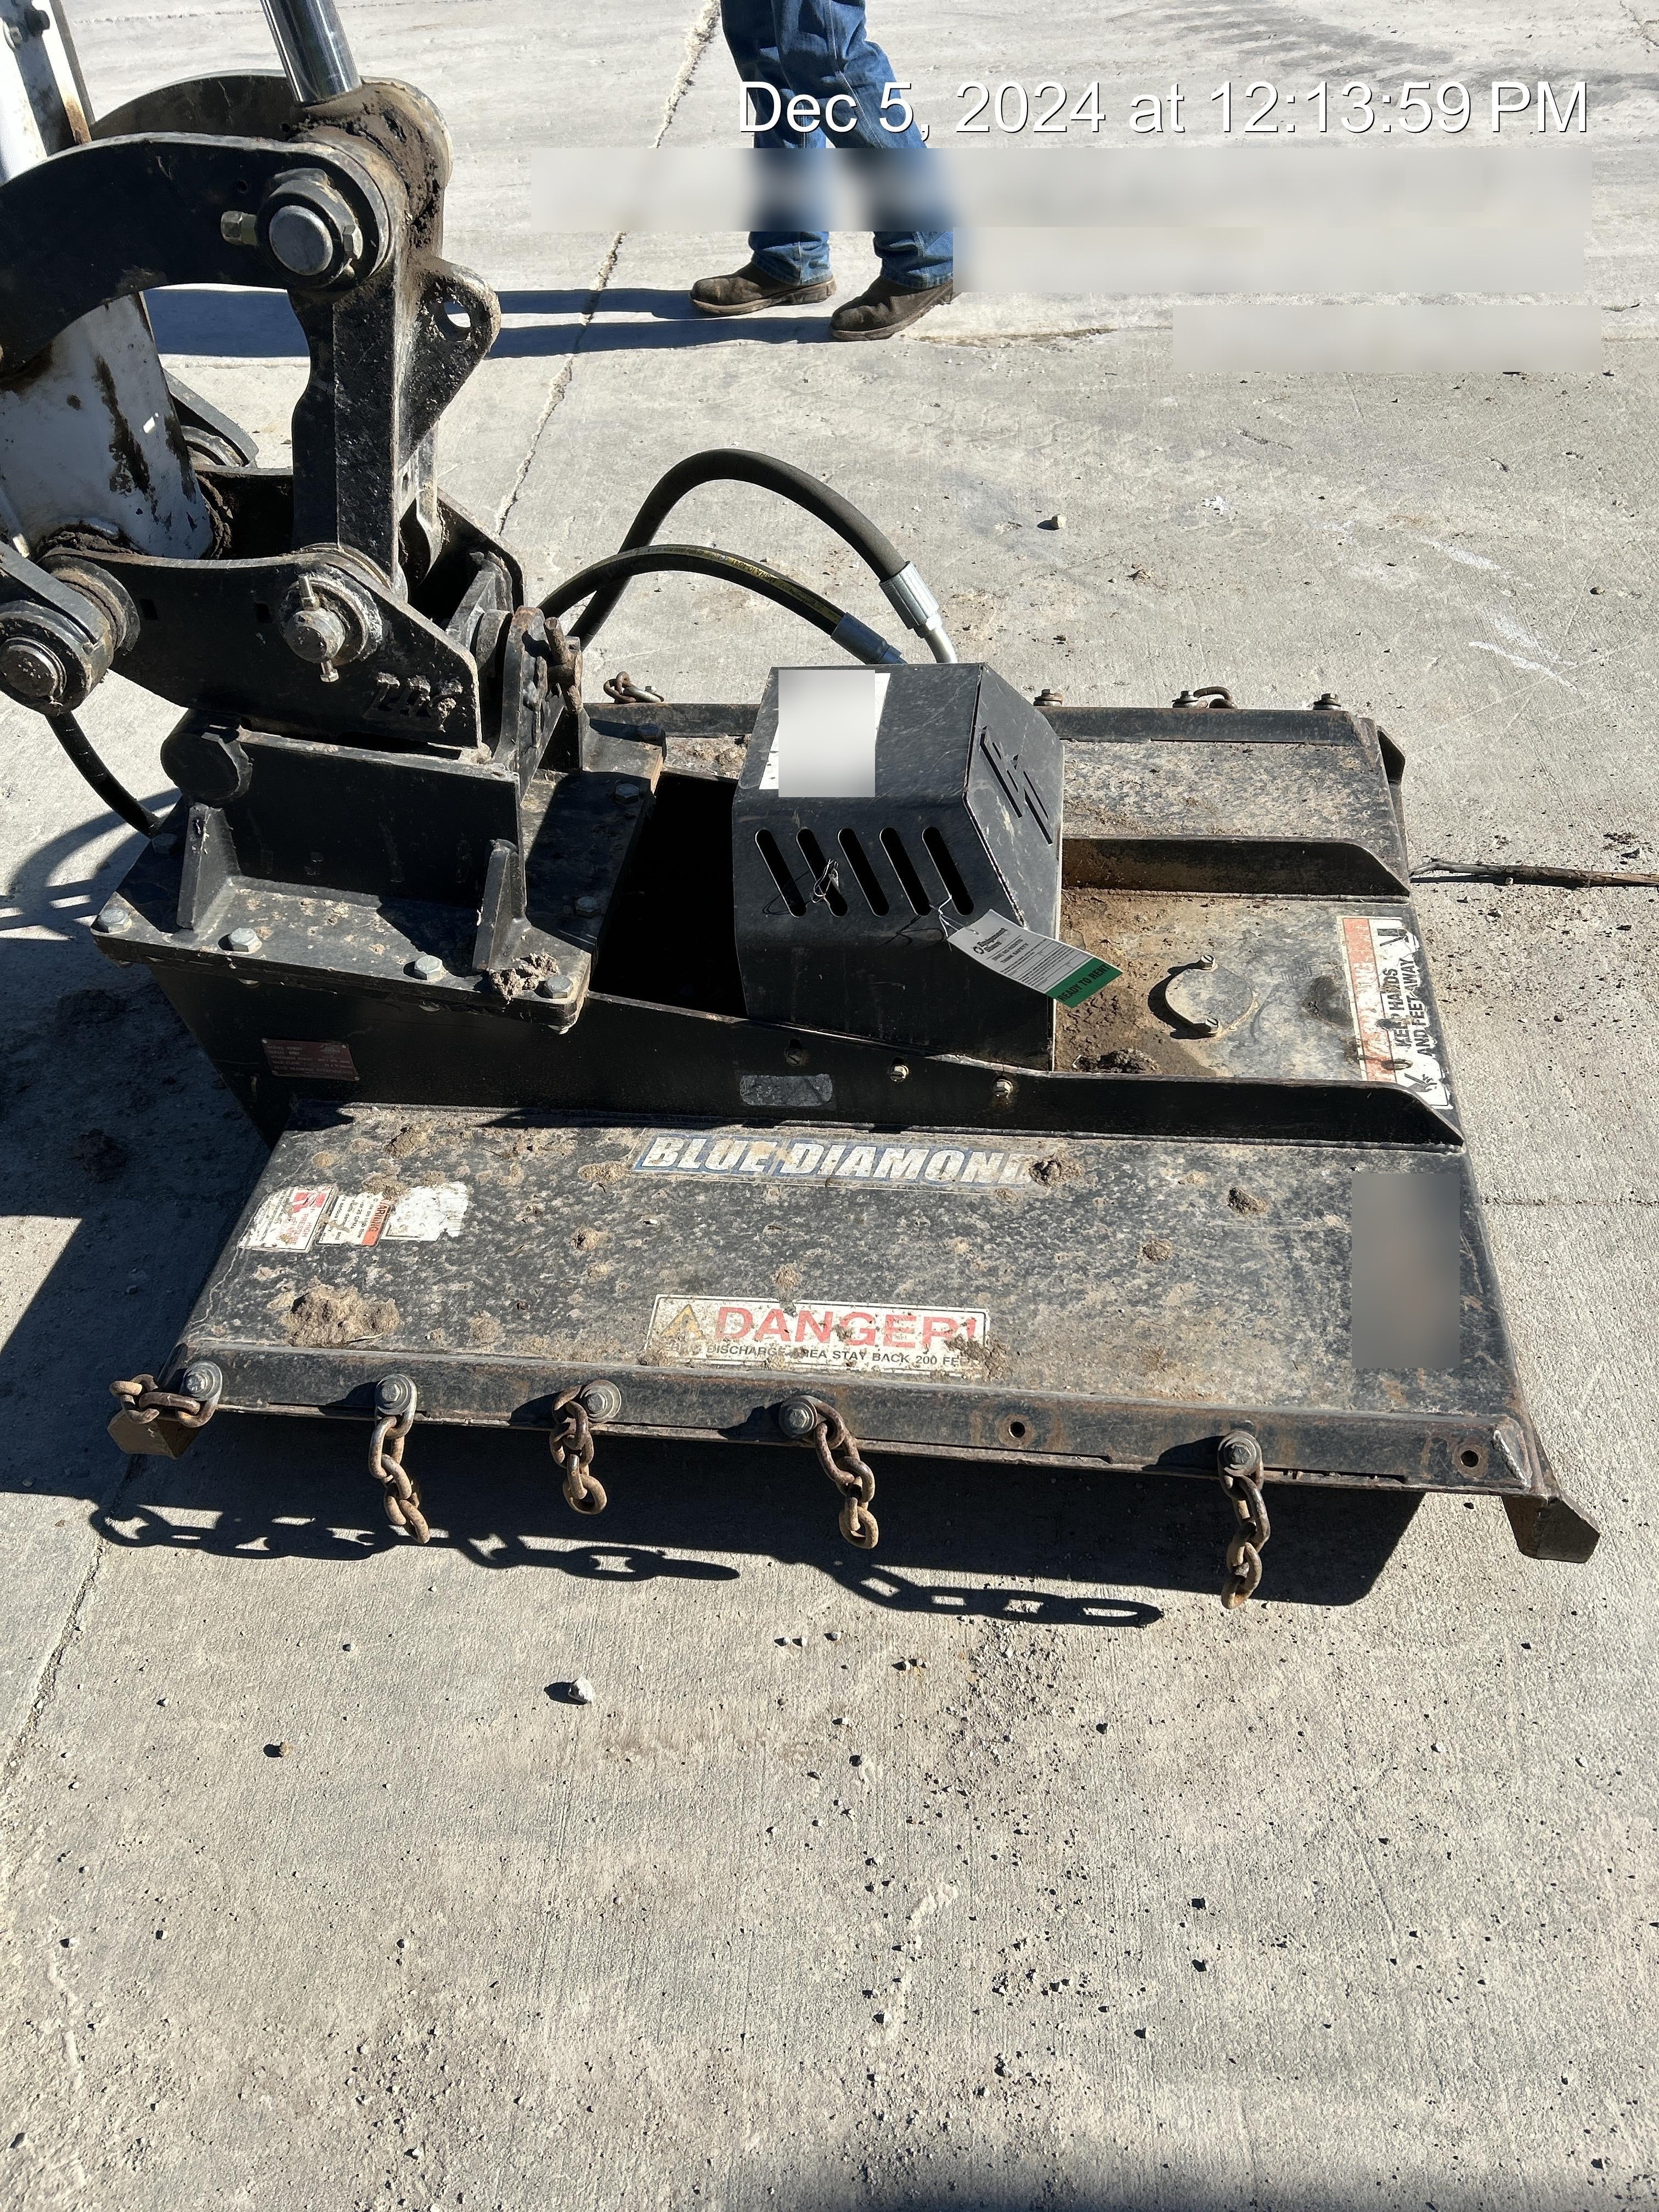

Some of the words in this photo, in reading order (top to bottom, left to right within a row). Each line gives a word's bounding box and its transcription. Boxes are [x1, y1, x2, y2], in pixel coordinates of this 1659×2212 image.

[1057, 983, 1082, 1002] READY
[1077, 977, 1092, 986] TO
[1088, 964, 1111, 980] RENT
[1400, 957, 1419, 991] AWAY
[1406, 995, 1427, 1026] FEET
[1413, 1029, 1437, 1058] AND
[641, 1137, 779, 1174] BLUE
[780, 1143, 1040, 1184] DIAMOND
[707, 1344, 786, 1357] DISCHARGE
[790, 1348, 827, 1358] REA
[832, 1350, 866, 1361] STAY
[872, 1353, 910, 1364] BACK
[916, 1356, 937, 1365] 200
